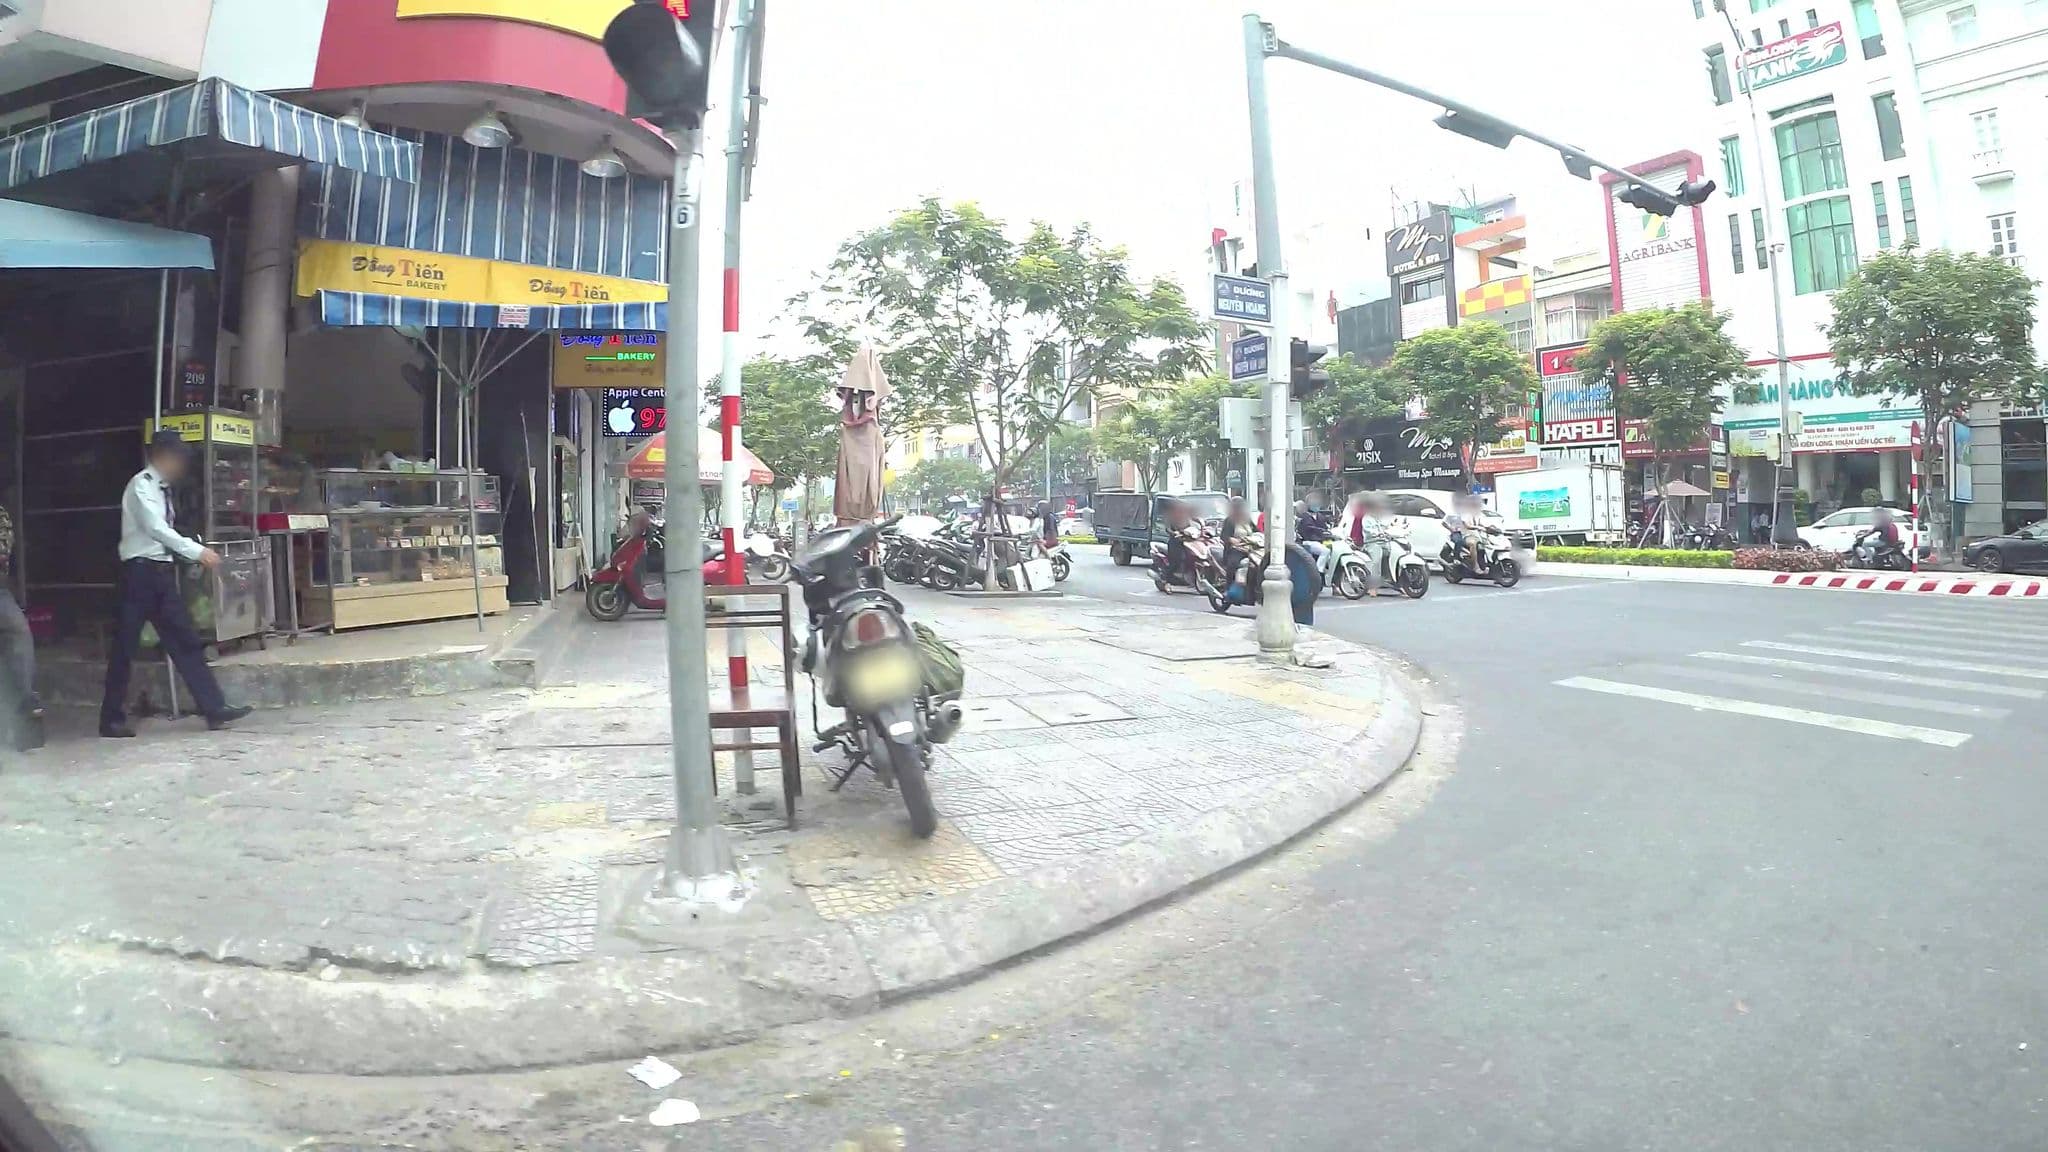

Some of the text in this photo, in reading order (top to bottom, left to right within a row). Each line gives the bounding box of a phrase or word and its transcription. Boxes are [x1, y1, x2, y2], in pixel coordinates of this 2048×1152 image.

[1623, 238, 1696, 262] AGRIBANK
[398, 258, 444, 280] Tiến
[406, 279, 448, 291] BAKERY
[569, 281, 609, 301] Tiến
[617, 352, 656, 361] BAKERY
[185, 372, 205, 385] 209
[608, 388, 638, 399] Apple
